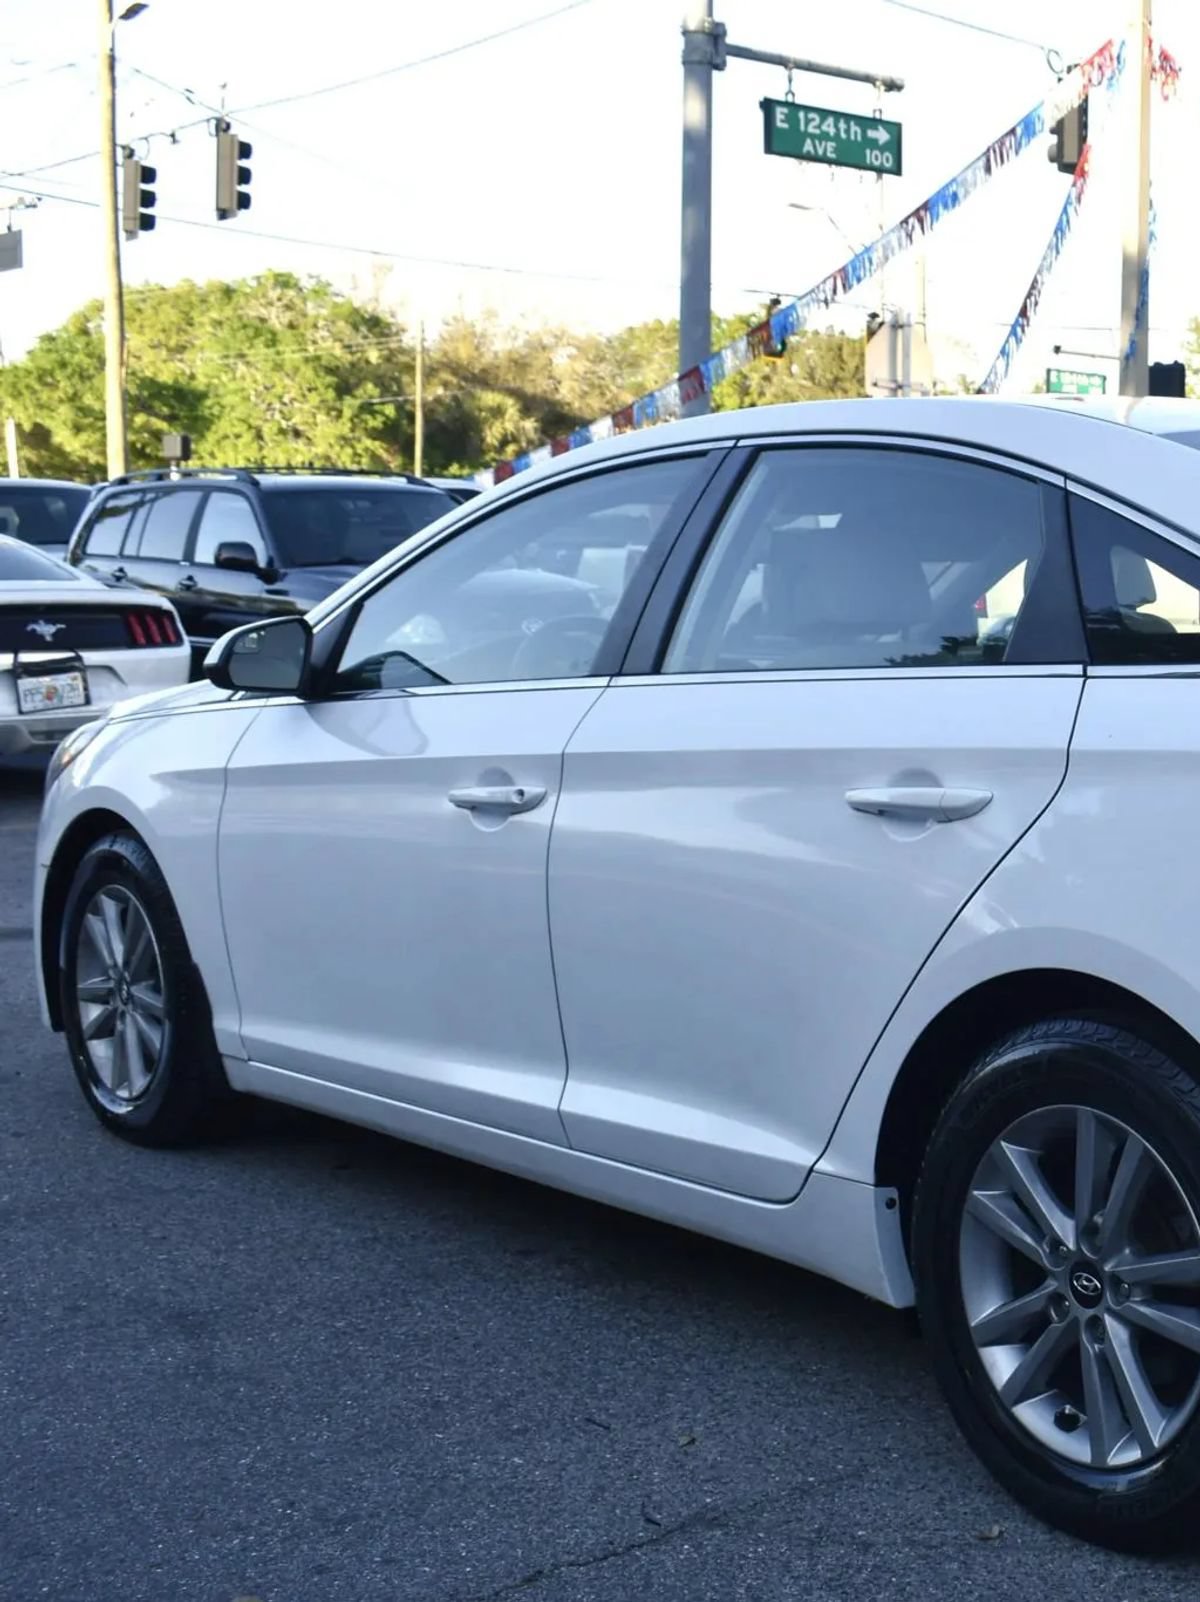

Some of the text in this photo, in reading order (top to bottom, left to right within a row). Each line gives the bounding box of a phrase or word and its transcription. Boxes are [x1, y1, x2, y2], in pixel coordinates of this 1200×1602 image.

[775, 107, 862, 142] E 124th
[803, 138, 893, 168] AVE 100
